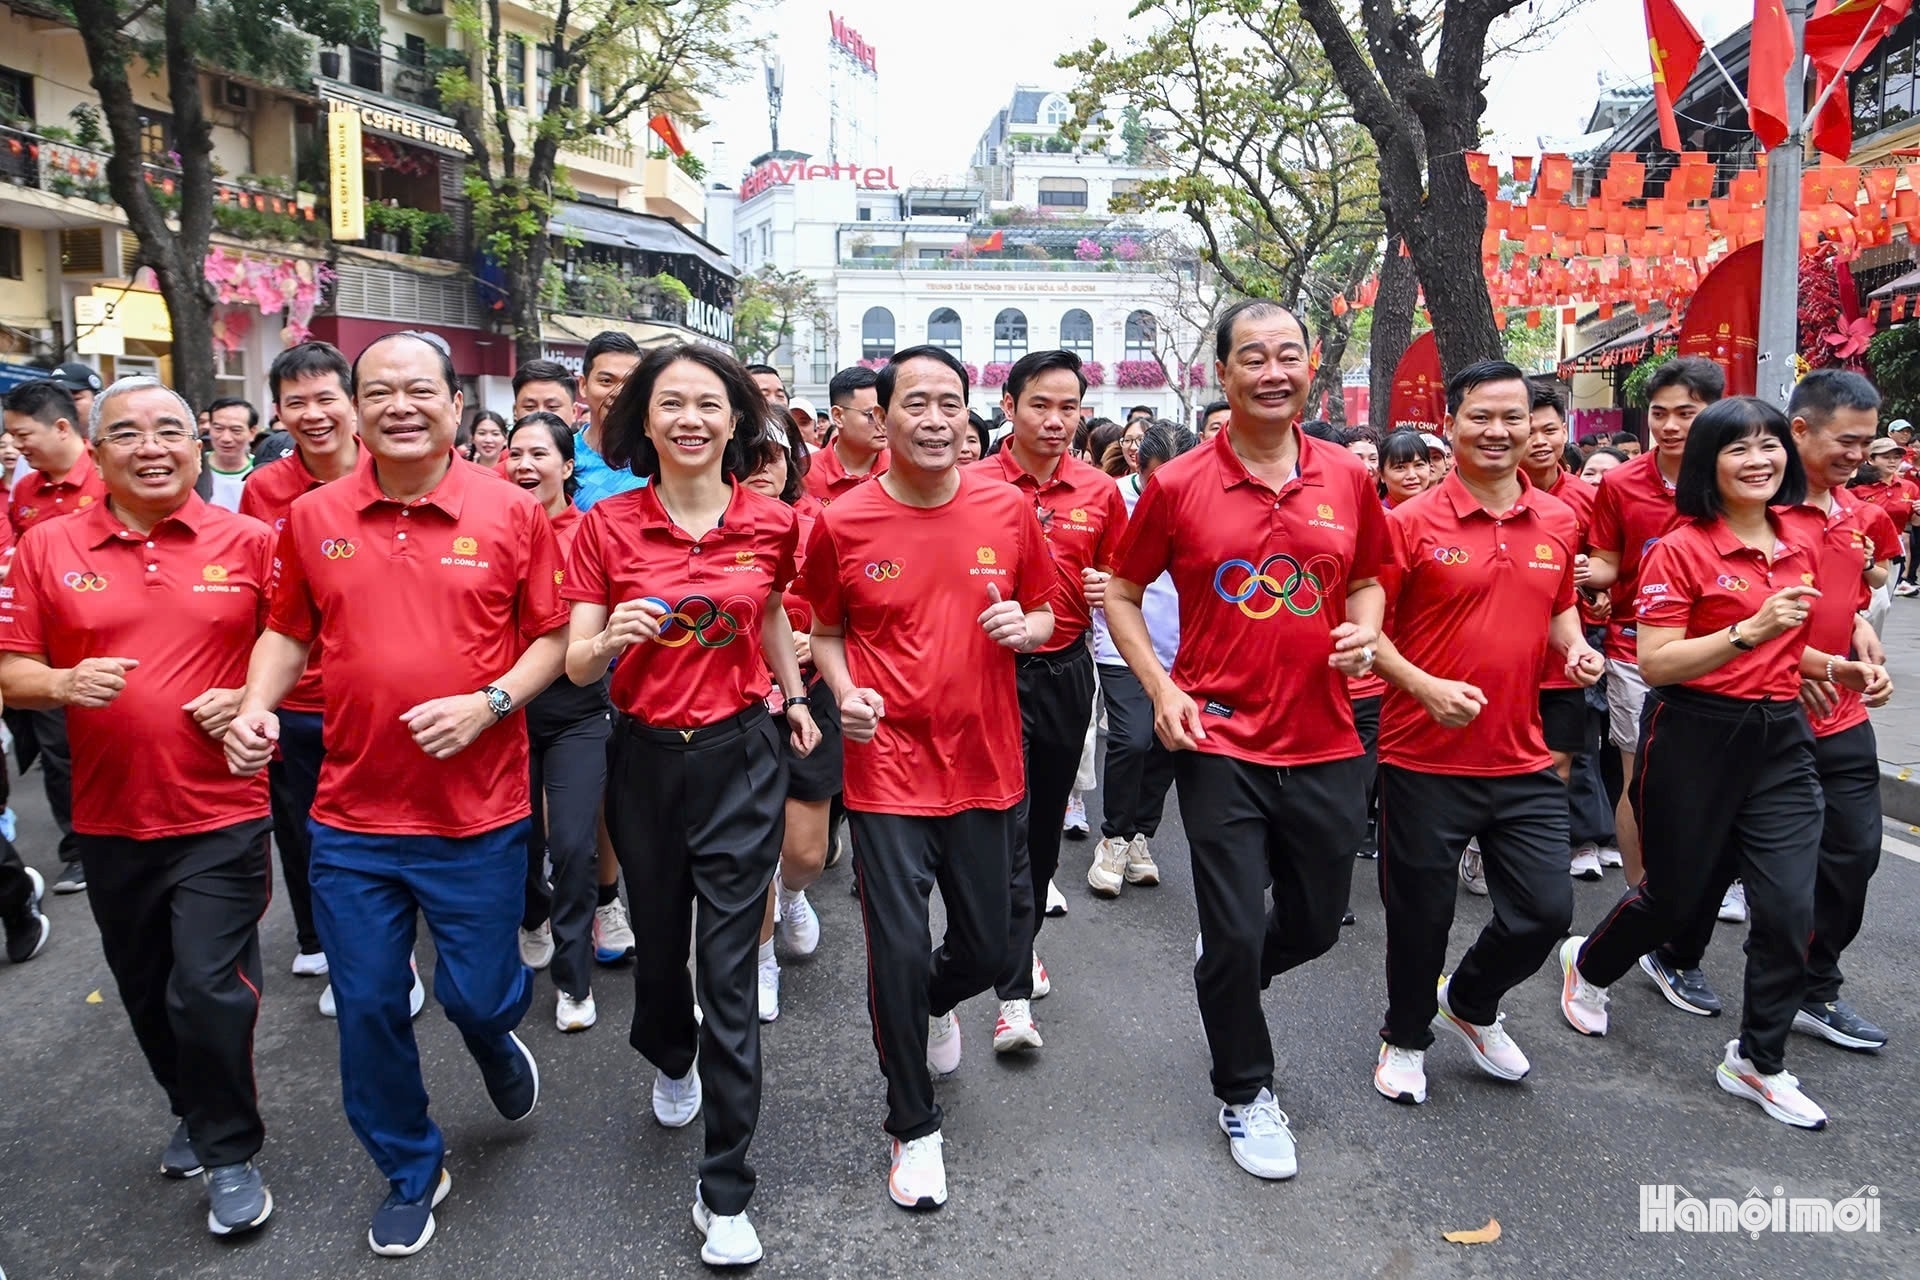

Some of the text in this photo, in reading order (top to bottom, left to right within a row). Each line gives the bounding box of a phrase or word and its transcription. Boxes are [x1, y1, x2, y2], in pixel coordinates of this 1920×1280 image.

[361, 108, 423, 139] COFFEE
[424, 125, 474, 155] HOUSE
[339, 123, 349, 227] THE COFFEE HOUSE
[769, 157, 899, 190] Viettel
[686, 298, 734, 342] BALCONY
[454, 558, 476, 567] CÔNG
